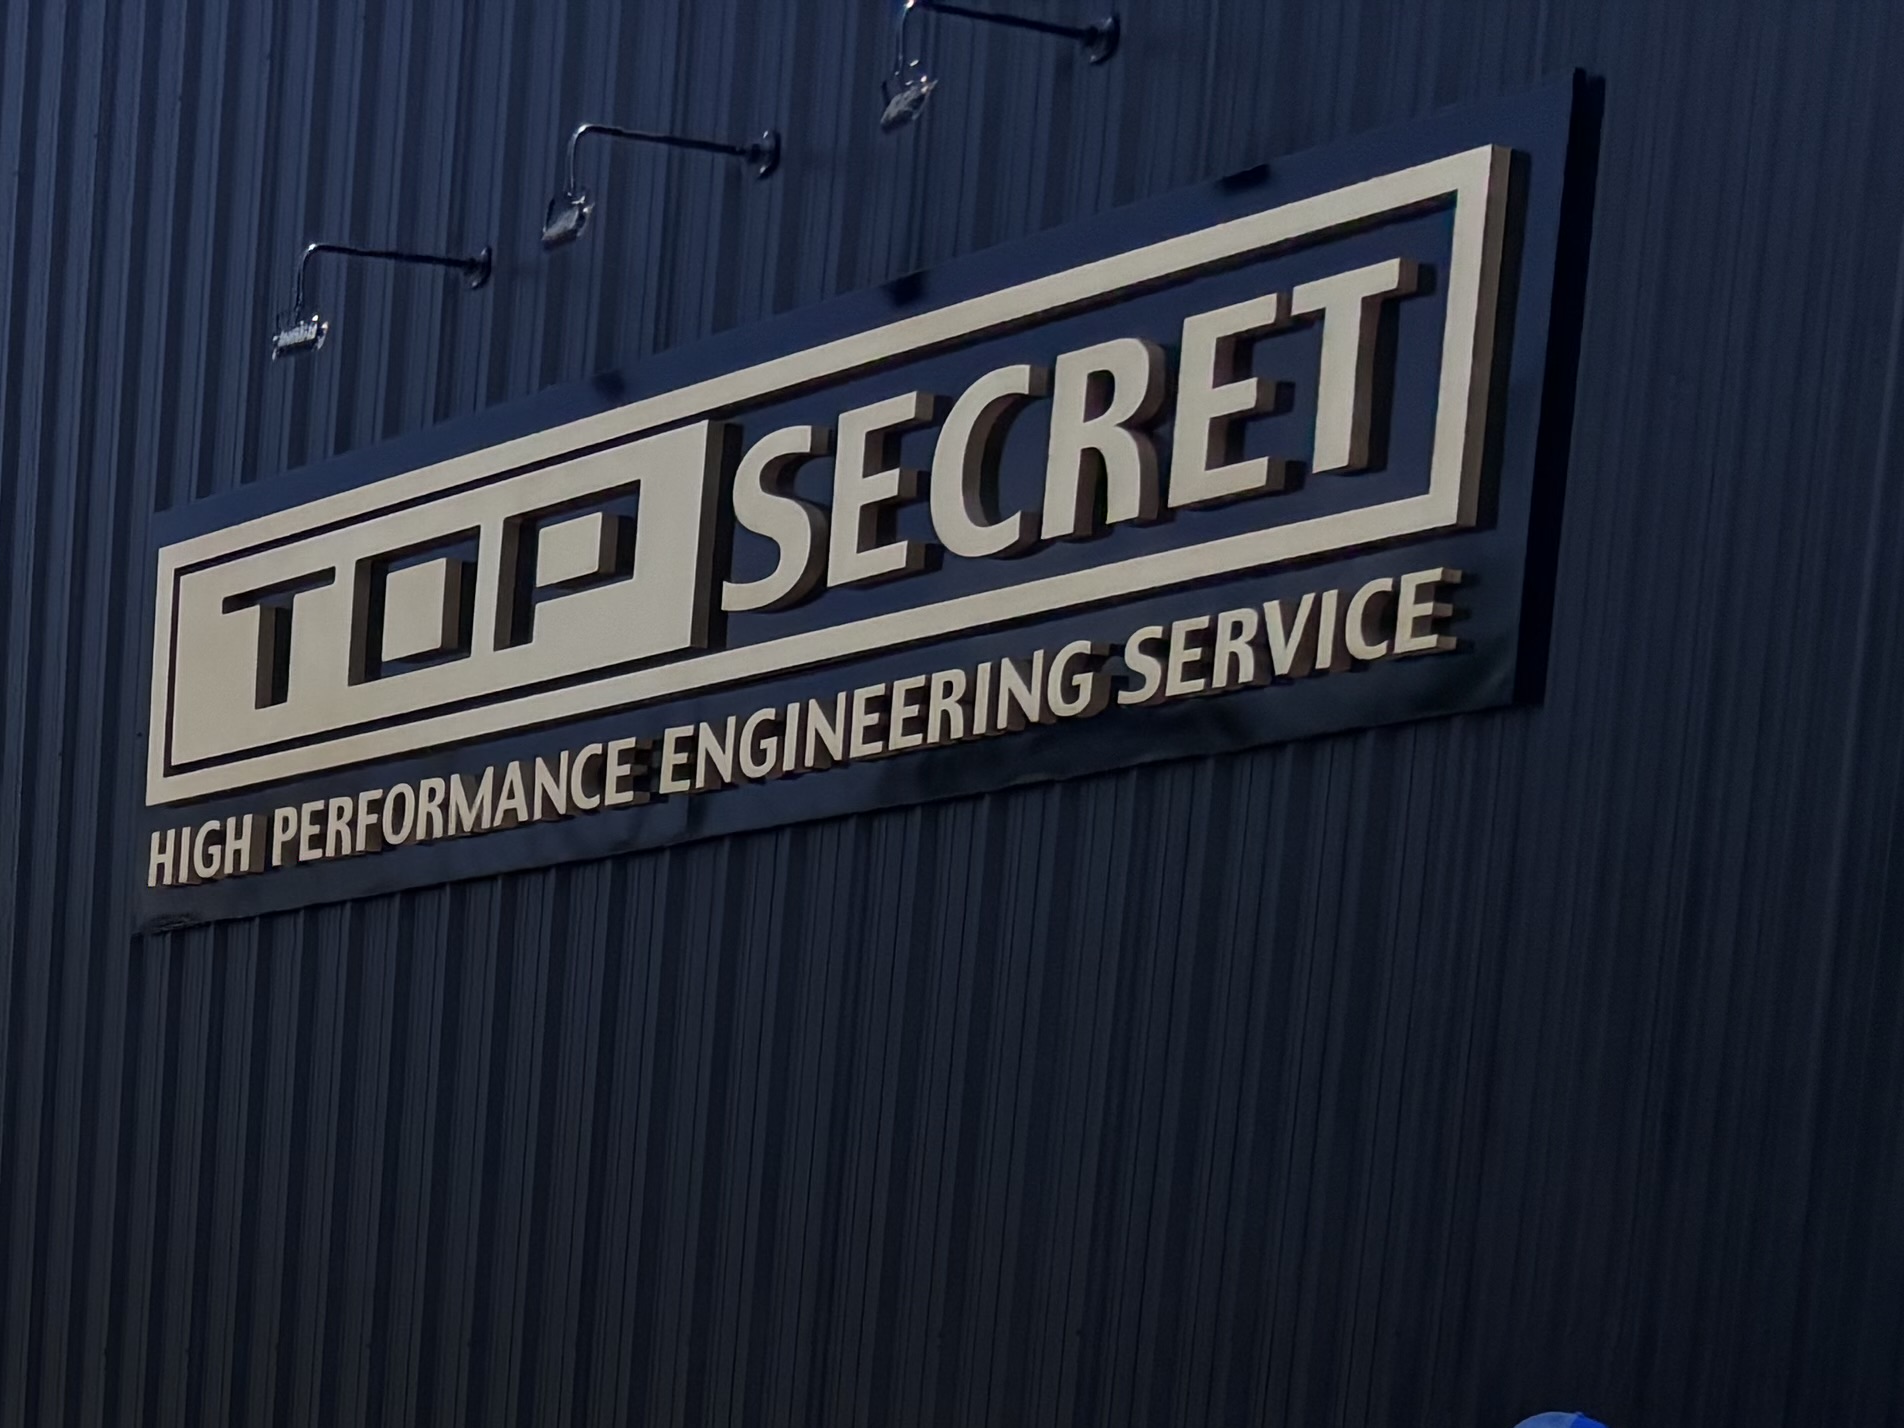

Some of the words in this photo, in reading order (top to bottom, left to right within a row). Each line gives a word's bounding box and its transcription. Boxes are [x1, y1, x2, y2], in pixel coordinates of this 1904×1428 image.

[223, 474, 643, 712] TOP
[722, 256, 1414, 614] SECRET
[148, 816, 253, 888] HIGH
[270, 737, 642, 868] PERFORMANCE
[660, 640, 1102, 795] ENGINEERING
[1119, 565, 1460, 706] SERVICE
